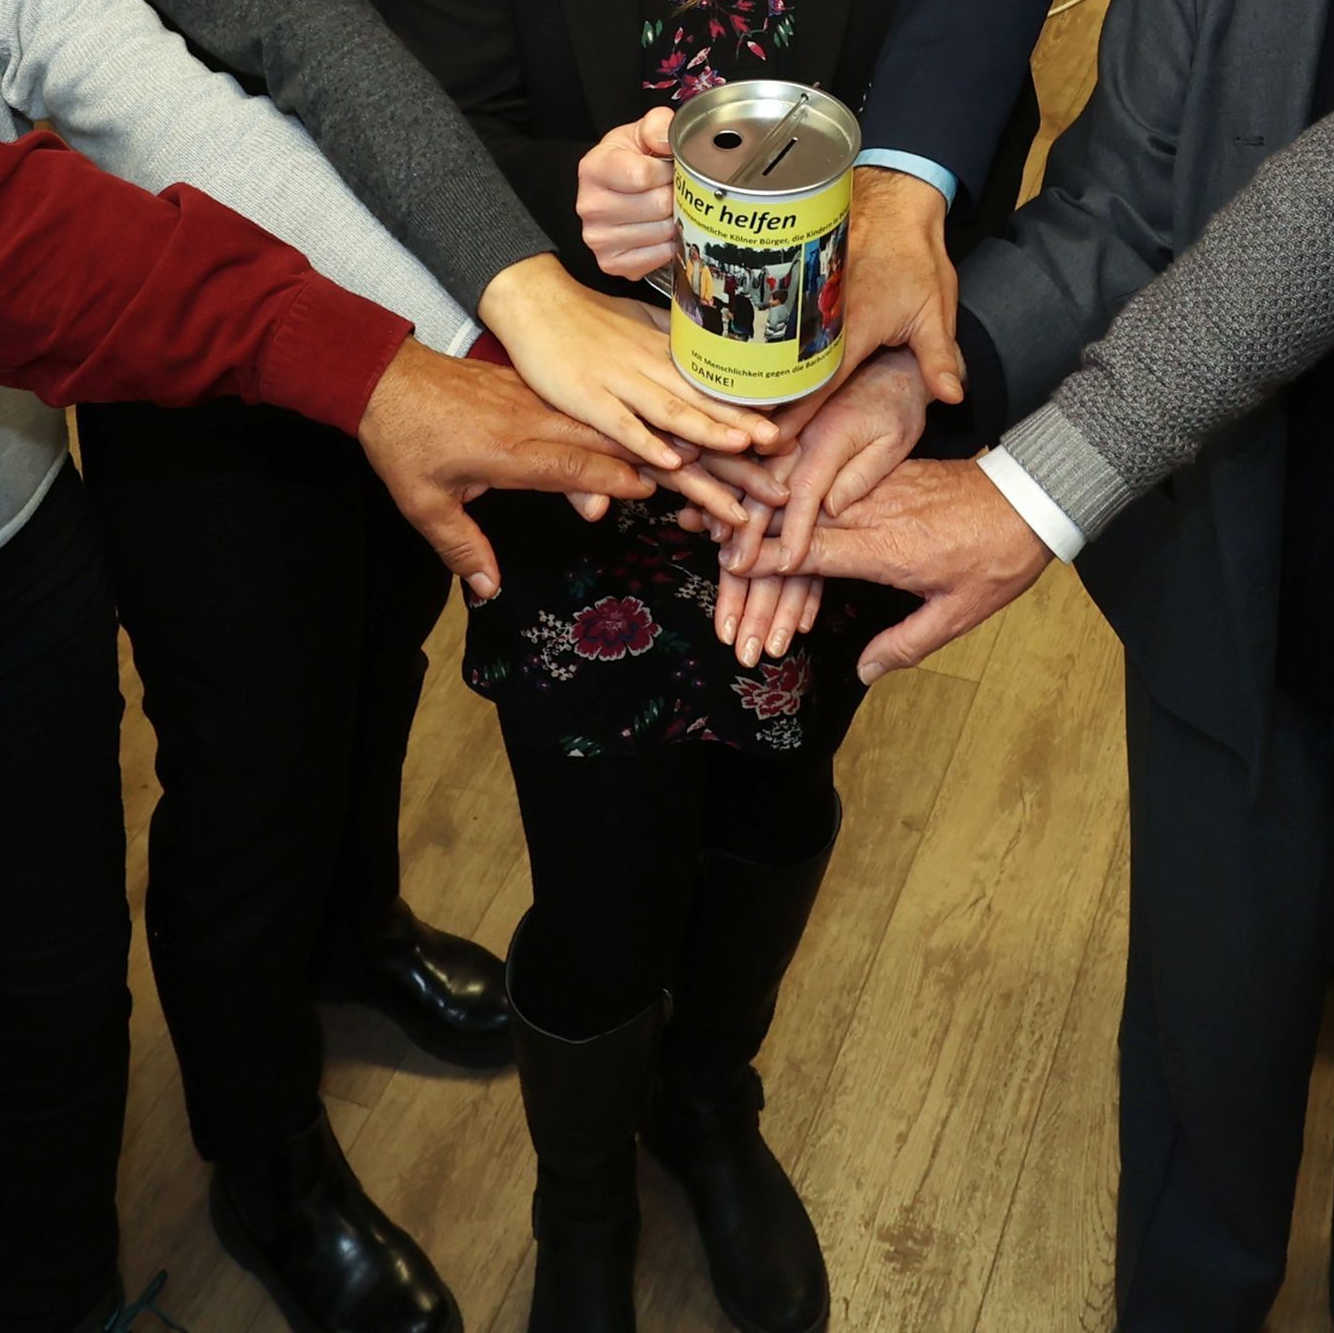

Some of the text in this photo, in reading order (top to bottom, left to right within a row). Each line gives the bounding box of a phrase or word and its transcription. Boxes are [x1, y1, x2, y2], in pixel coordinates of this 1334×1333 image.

[675, 169, 714, 216] ölner
[719, 206, 797, 234] helfen
[730, 233, 757, 245] Kölner
[792, 234, 805, 243] die
[691, 362, 735, 388] DANKE!
[703, 357, 764, 378] Menschlichkeit
[765, 368, 791, 379] gegen
[792, 365, 805, 374] die
